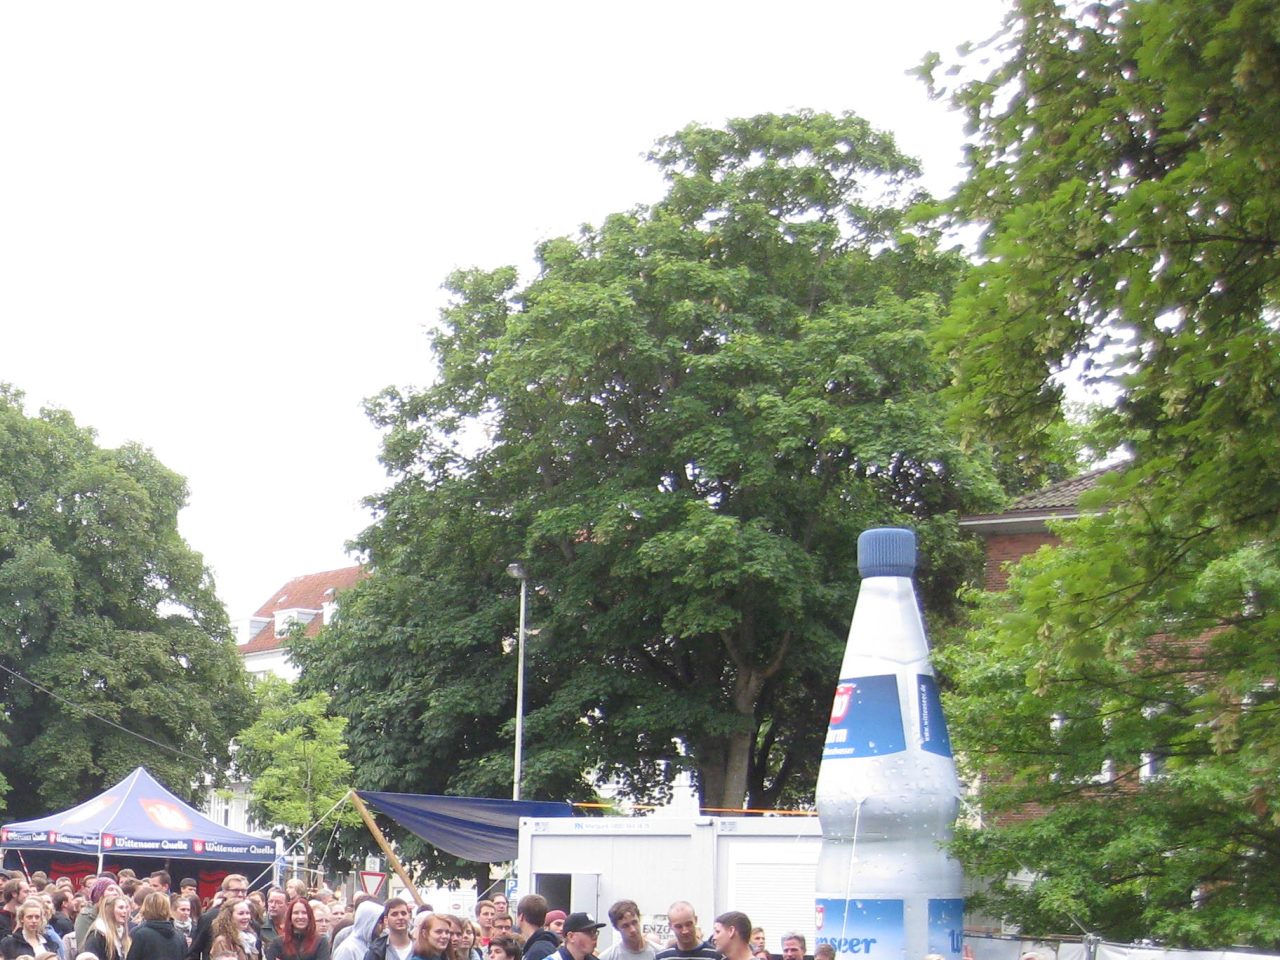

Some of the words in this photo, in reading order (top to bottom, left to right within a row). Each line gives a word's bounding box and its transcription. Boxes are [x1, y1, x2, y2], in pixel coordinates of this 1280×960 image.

[114, 837, 161, 849] Wittenseer
[161, 840, 189, 850] Quelle
[204, 841, 249, 854] Wittenseer
[249, 844, 275, 855] Quelle
